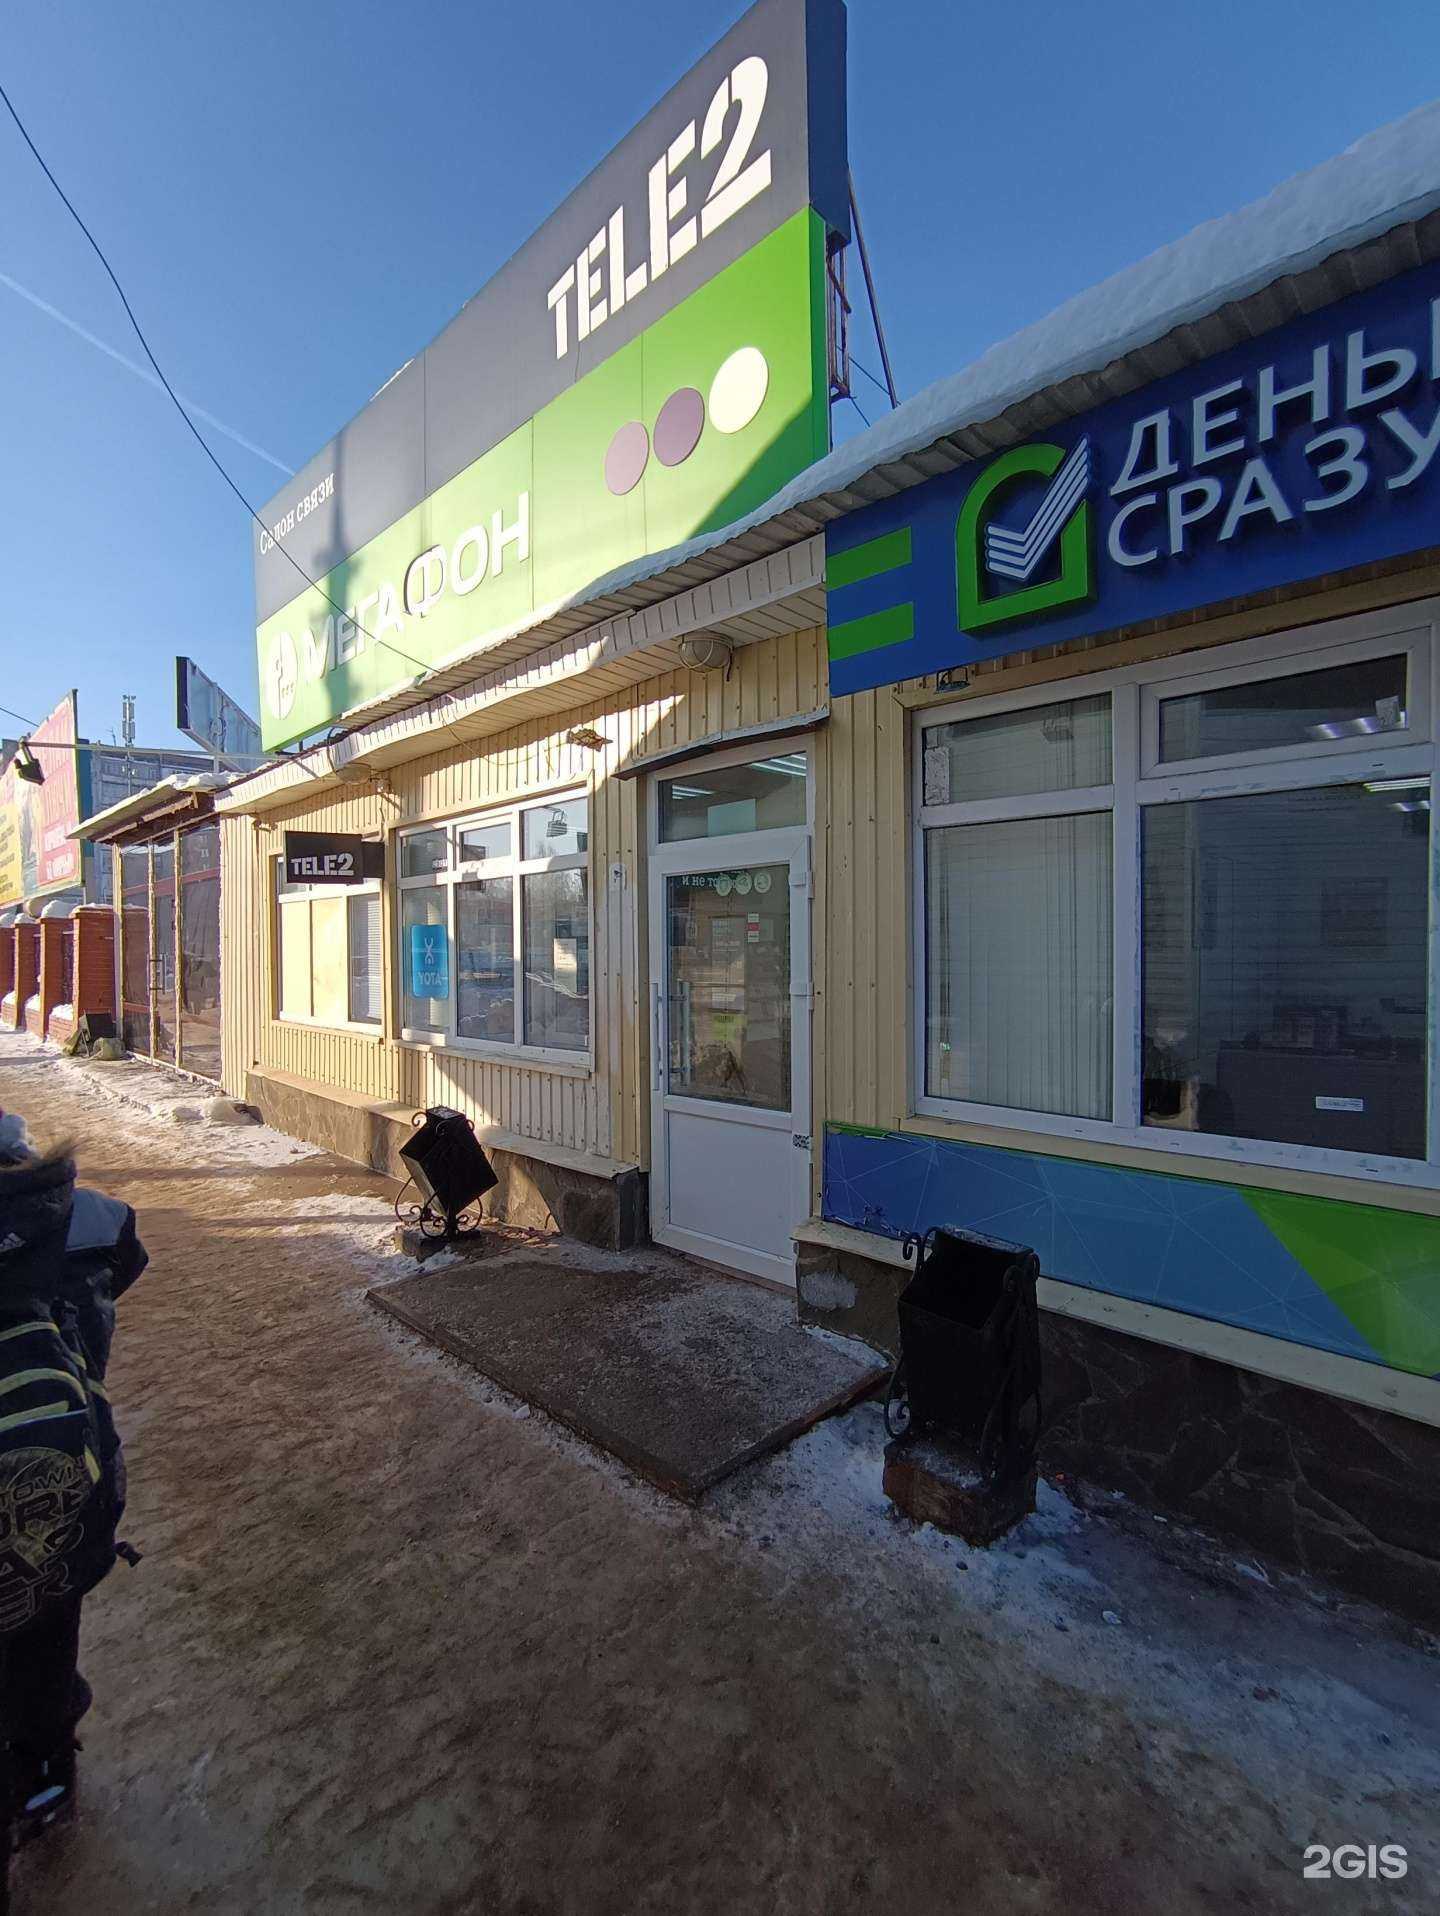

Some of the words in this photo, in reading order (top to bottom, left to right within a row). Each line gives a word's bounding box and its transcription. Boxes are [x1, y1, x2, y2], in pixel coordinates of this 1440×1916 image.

[547, 56, 771, 360] TELE2
[1107, 408, 1440, 567] СРАЗУ
[290, 853, 355, 876] TELE2
[417, 971, 443, 986] YOTA
